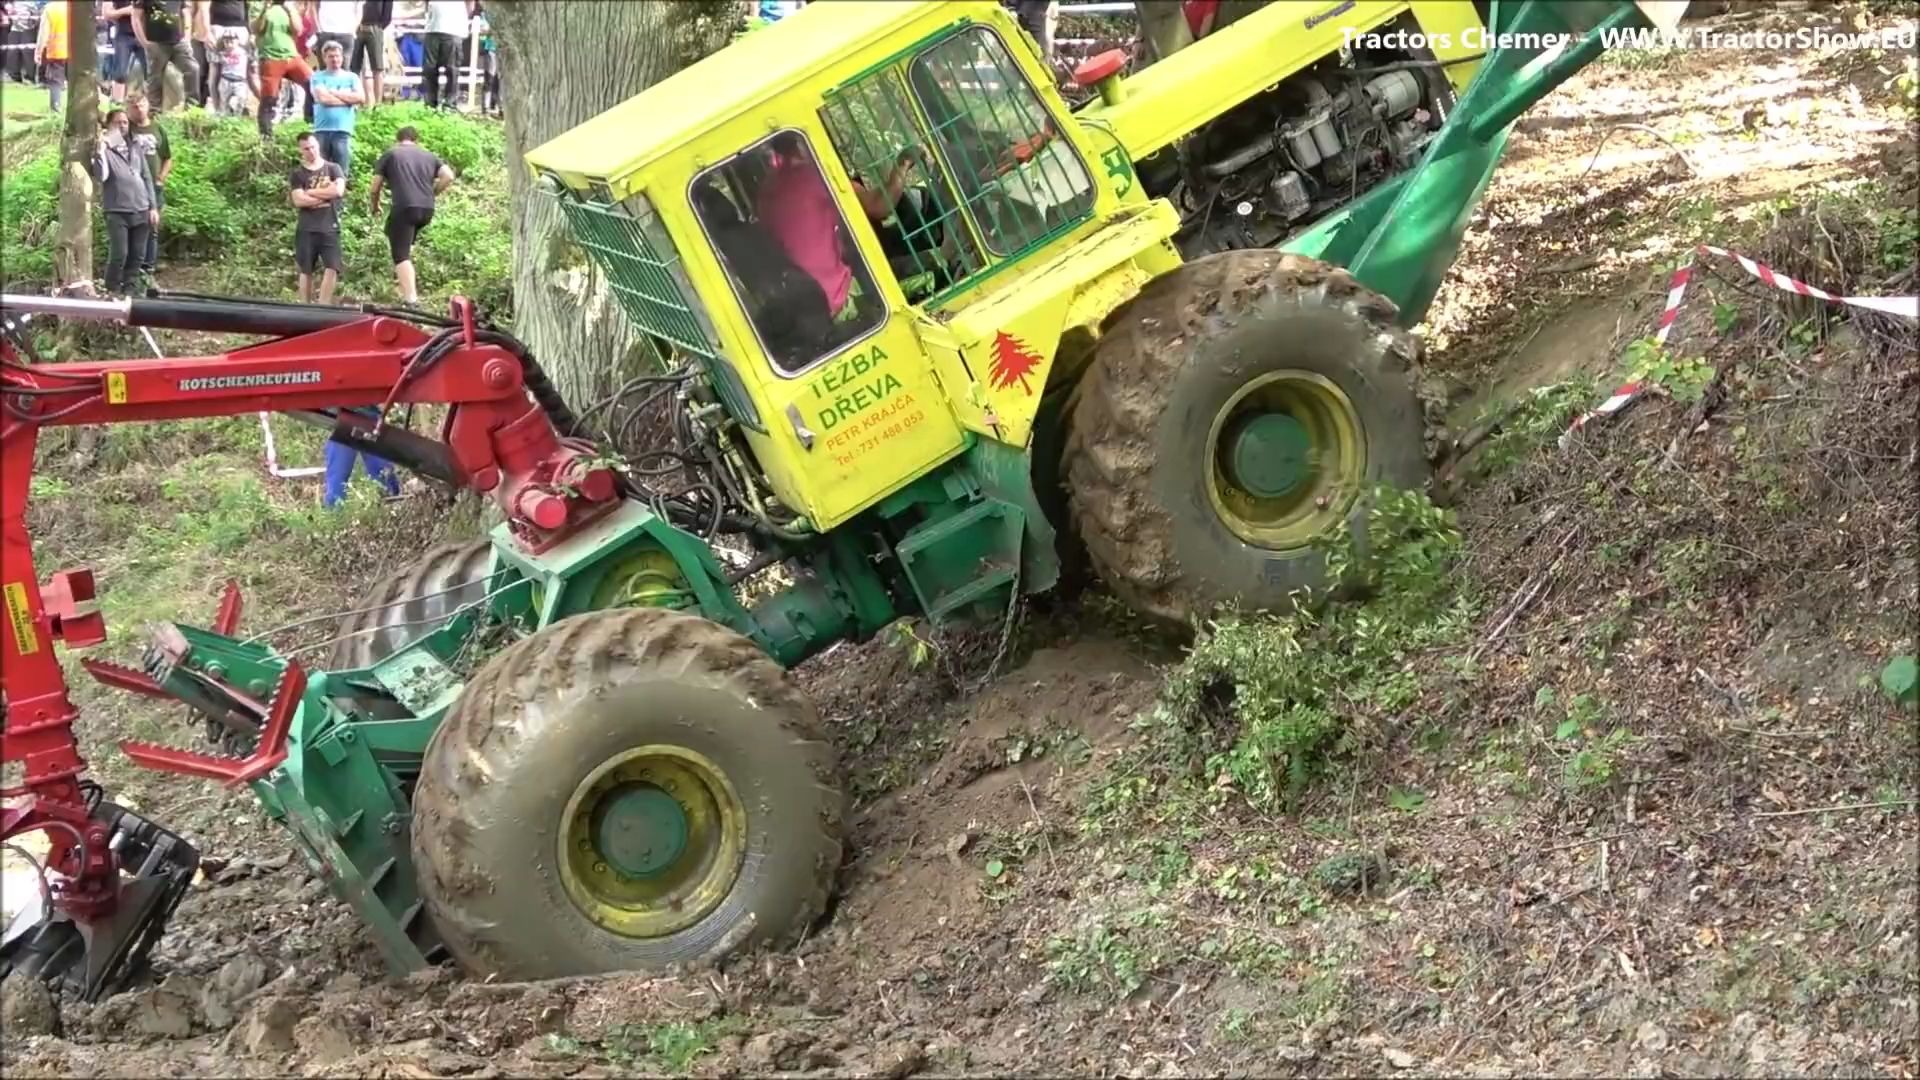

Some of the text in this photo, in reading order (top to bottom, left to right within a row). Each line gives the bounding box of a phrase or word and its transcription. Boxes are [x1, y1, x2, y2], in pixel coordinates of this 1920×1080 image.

[178, 371, 321, 391] KOTSCHENREUTHER
[818, 373, 903, 430] DŘEVA
[826, 394, 915, 451] PETR KRAJČA
